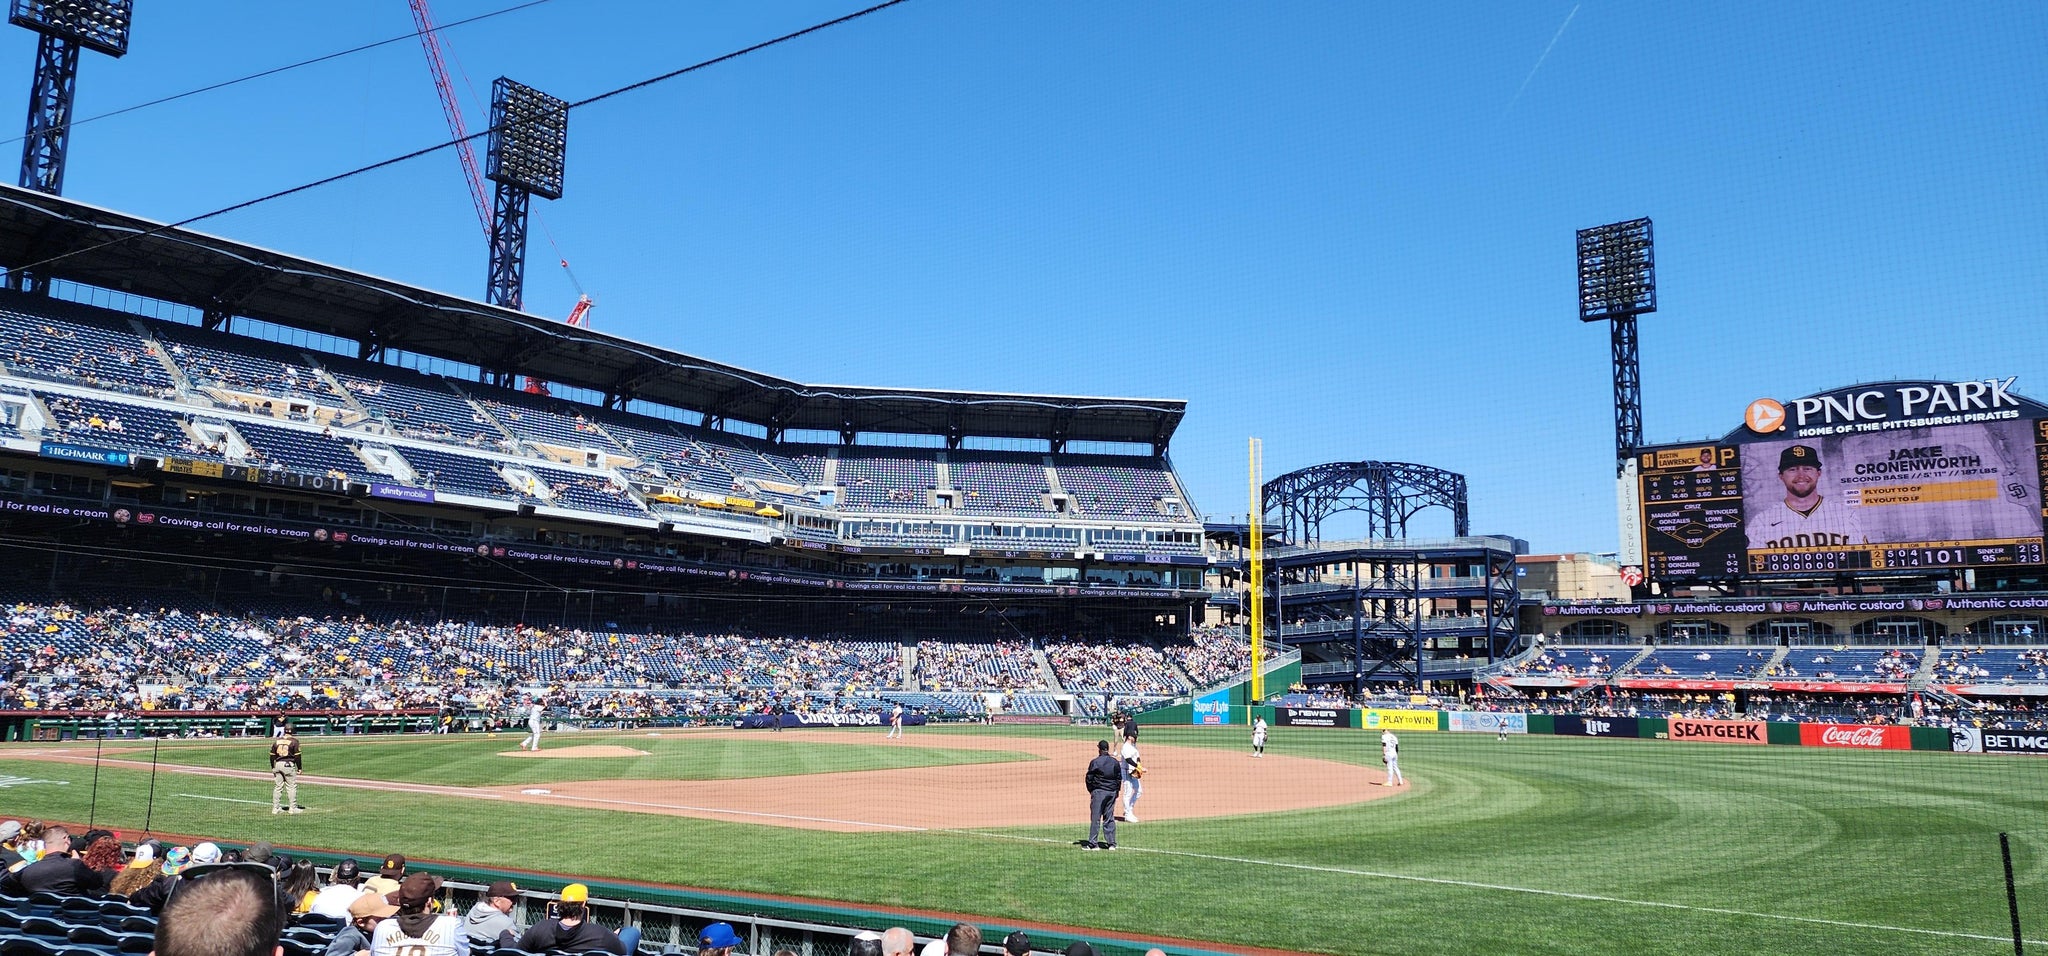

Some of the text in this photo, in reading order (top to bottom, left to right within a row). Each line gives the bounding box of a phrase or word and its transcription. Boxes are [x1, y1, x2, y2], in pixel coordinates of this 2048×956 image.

[1792, 376, 2019, 425] PNC PARK
[1799, 410, 2019, 437] HOME OF THE PITTSBURGH PIRATES
[48, 446, 104, 460] HIGHMARK
[1720, 448, 1735, 466] P
[1888, 446, 1942, 460] JAKE
[1643, 454, 1653, 468] 61
[1659, 458, 1696, 466] LAWRENCE
[1855, 455, 1980, 475] CRONENWORTH
[170, 464, 193, 473] PIRATES
[299, 475, 338, 490] 1 0 1
[380, 487, 403, 496] xfinity
[680, 490, 687, 498] OF
[726, 497, 755, 508] BOURBON
[7, 501, 24, 510] for
[27, 503, 49, 513] real
[53, 505, 70, 514] ice
[73, 508, 108, 518] cream
[159, 515, 204, 530] Cravings
[206, 521, 224, 530] call
[226, 522, 240, 532] for
[242, 524, 261, 534] real
[263, 526, 278, 535] ice
[280, 529, 310, 538] cream
[351, 534, 388, 546] Cravings
[389, 538, 404, 546] call
[419, 541, 435, 549] real
[436, 543, 449, 551] ice
[450, 545, 474, 553] cream
[508, 550, 538, 560] Cravings
[1925, 550, 1962, 564] 1 0 1
[639, 563, 664, 571] Cravings
[1559, 606, 1602, 615] Authentic
[1604, 605, 1641, 614] custard
[1674, 603, 1723, 613] Authentic
[1725, 603, 1765, 612] custard
[1803, 600, 1857, 611] Authentic
[1860, 600, 1904, 610] custard
[1946, 598, 2006, 609] Authentic
[796, 711, 881, 726] Chicken Sea
[1383, 715, 1404, 724] PLAY
[1414, 716, 1435, 725] WIN!
[1585, 720, 1610, 736] Lite
[1674, 722, 1760, 741] SEATGEEK
[1822, 726, 1885, 746] Coca-Cola
[1985, 735, 2048, 748] BETMG
[386, 930, 440, 946] MADO
